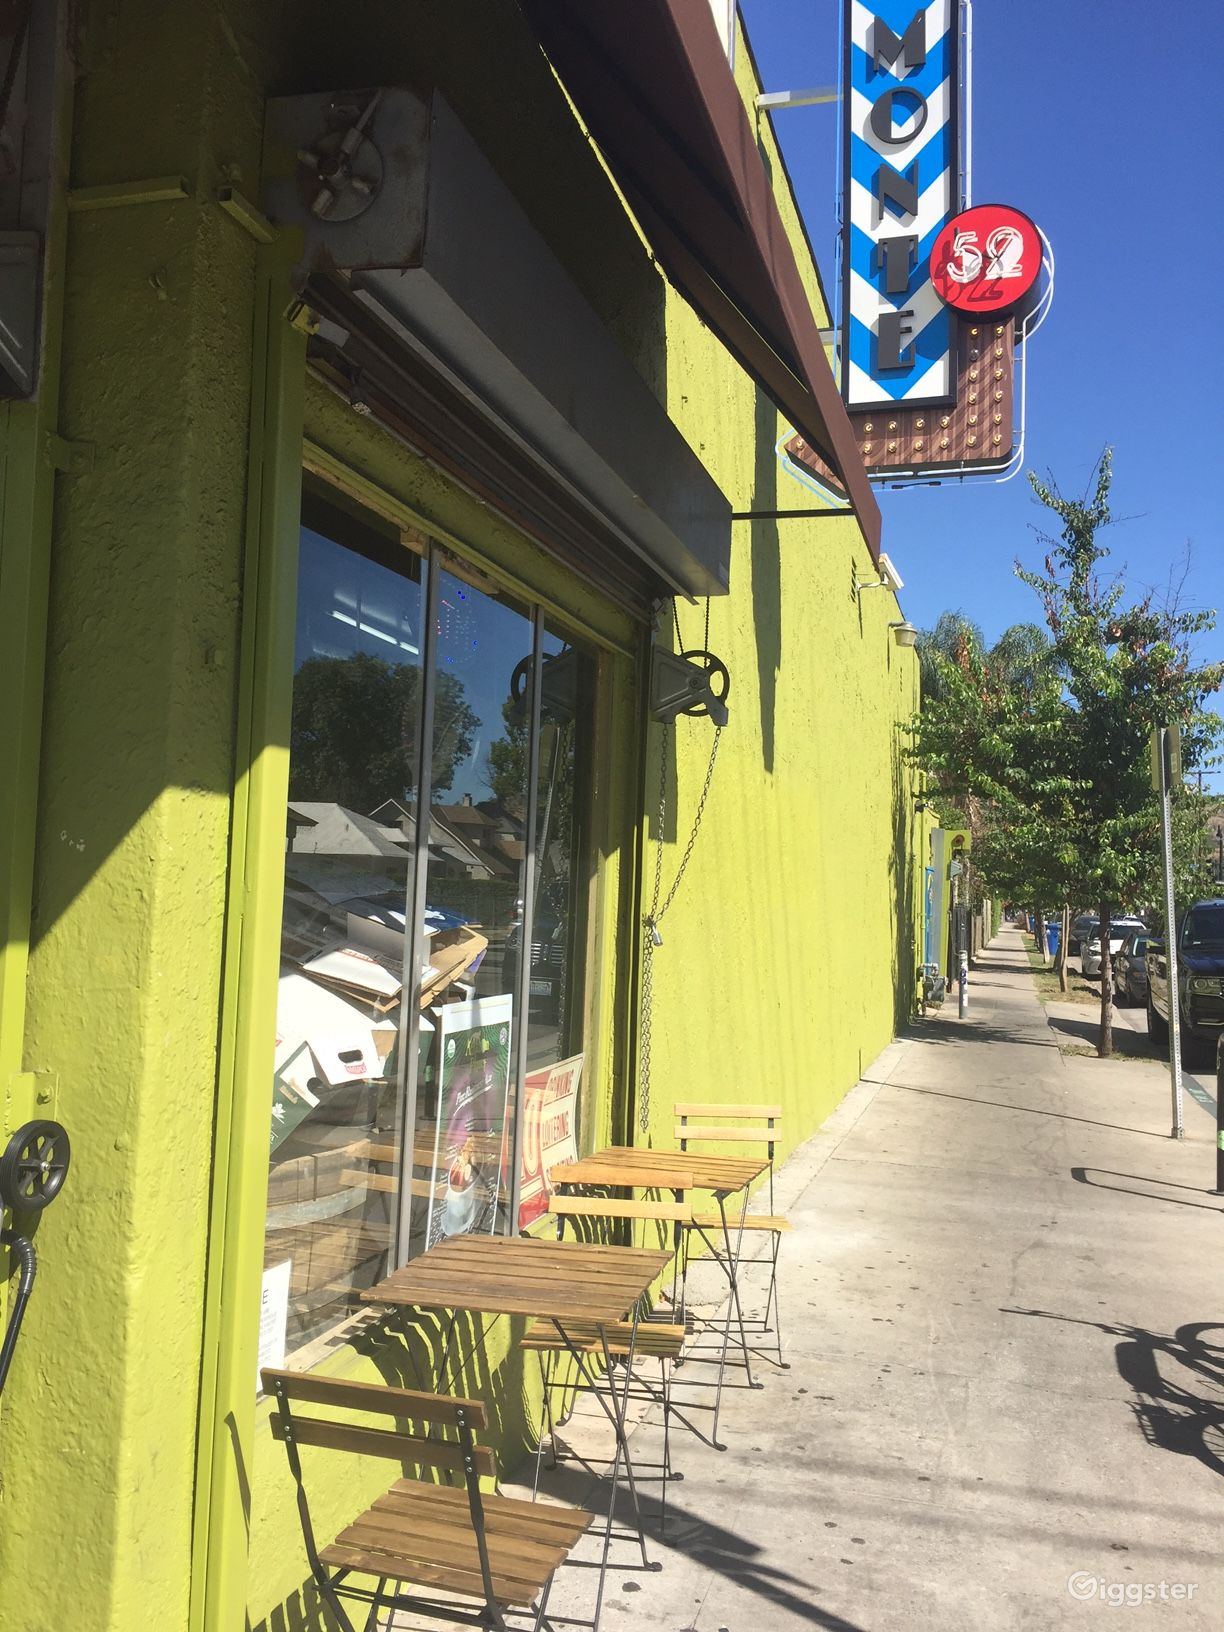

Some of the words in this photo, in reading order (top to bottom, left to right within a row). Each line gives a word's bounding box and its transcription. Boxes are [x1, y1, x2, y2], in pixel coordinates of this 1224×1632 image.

[870, 8, 928, 370] MONTE
[947, 226, 1023, 283] 52
[542, 1110, 569, 1147] LOITERING
